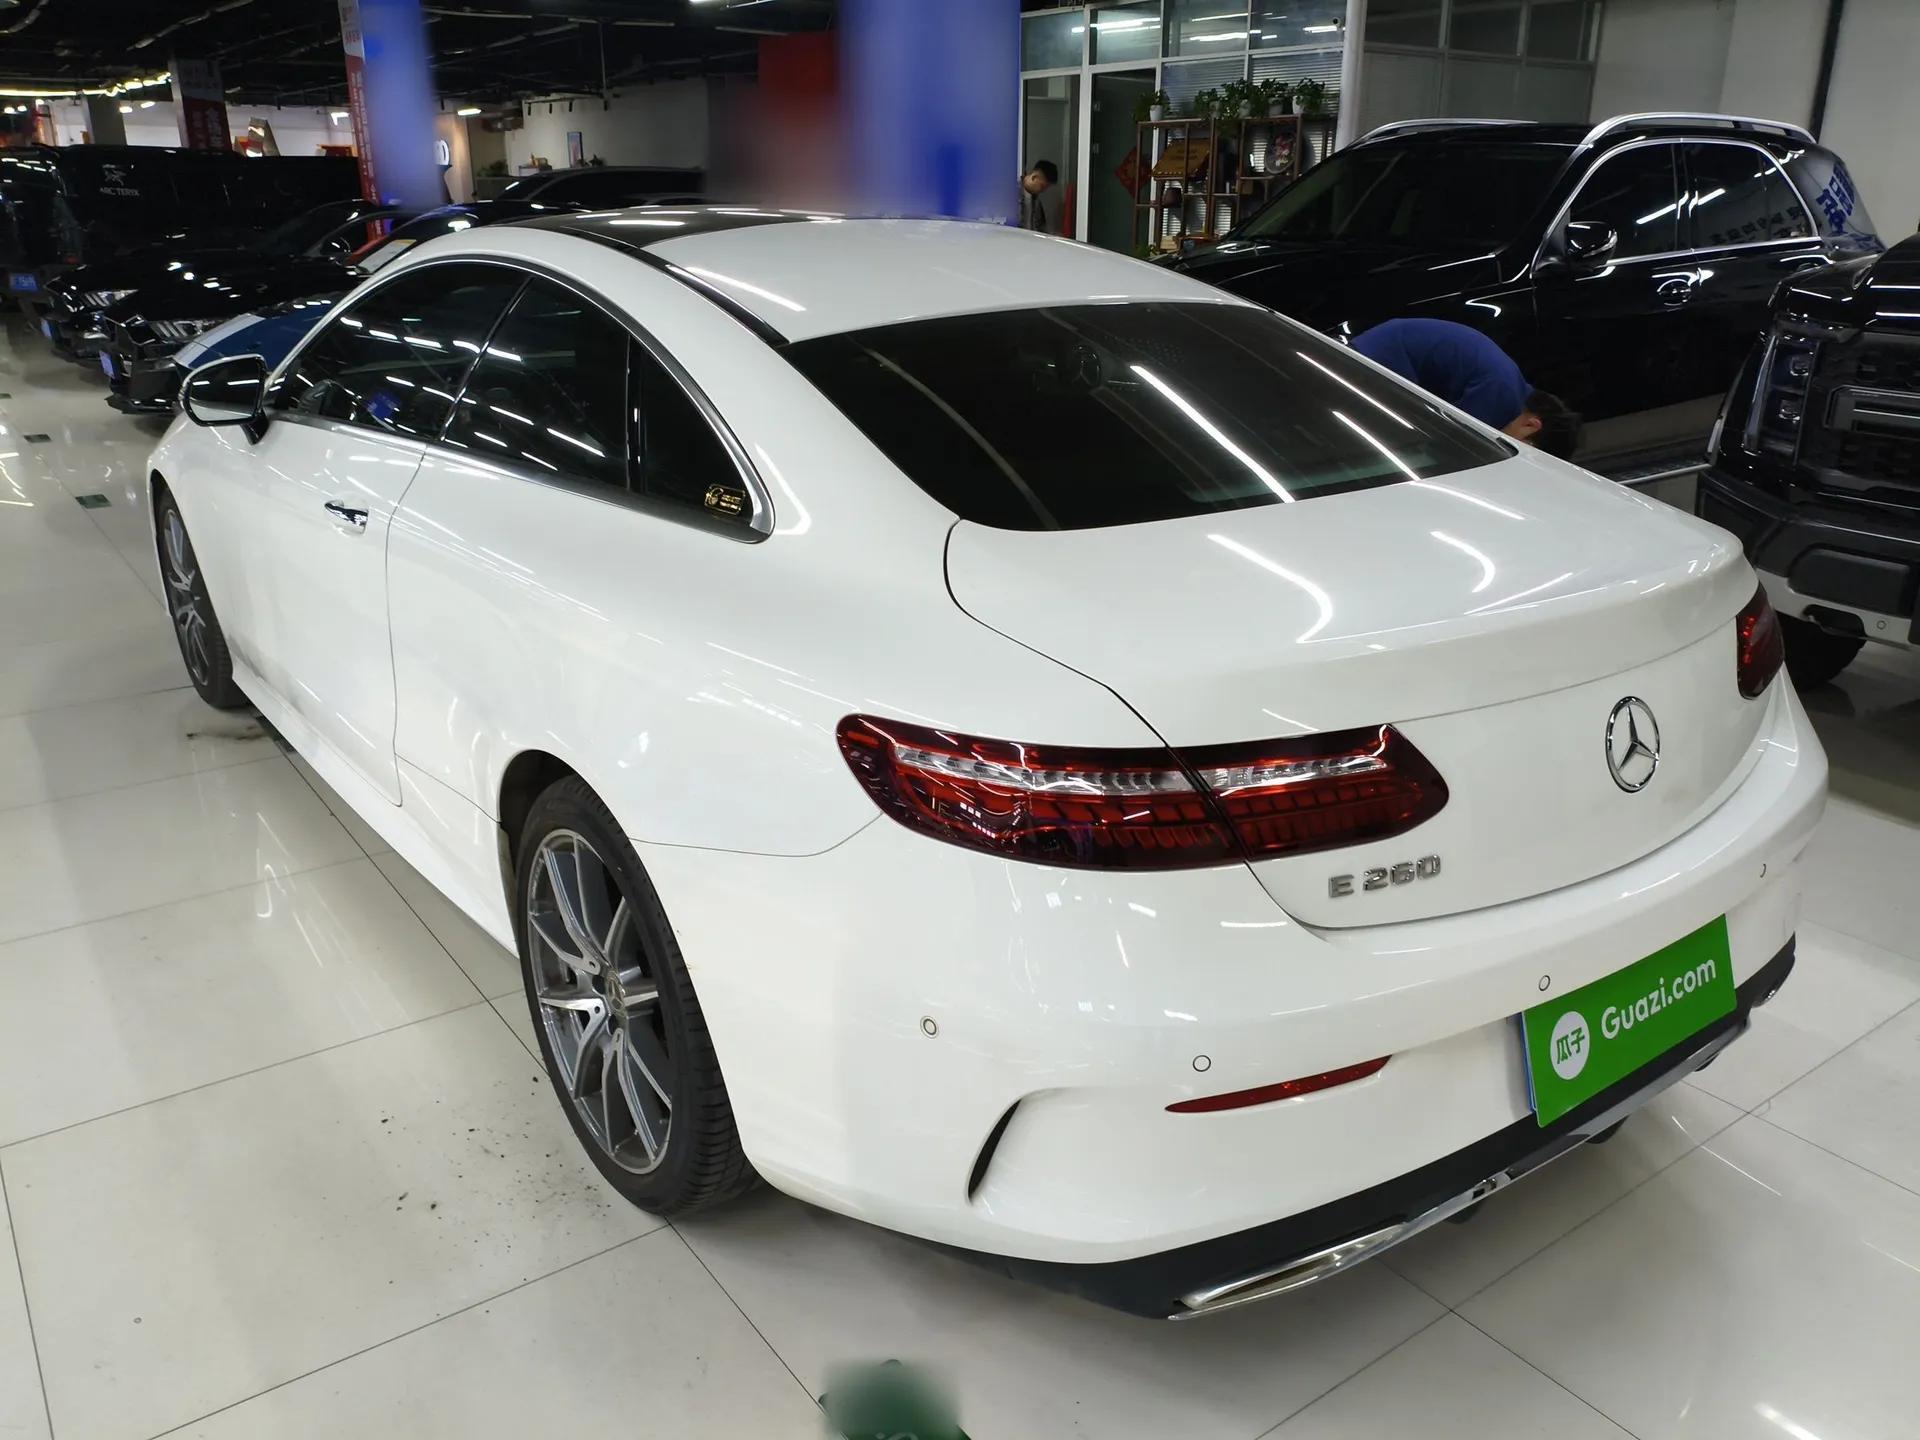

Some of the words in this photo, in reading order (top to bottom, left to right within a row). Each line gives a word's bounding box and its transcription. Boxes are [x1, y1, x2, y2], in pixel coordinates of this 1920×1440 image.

[1328, 874, 1354, 898] E
[1363, 855, 1441, 891] 260
[1601, 959, 1716, 1039] Guazi.com
[1556, 1027, 1585, 1064] 瓜子
